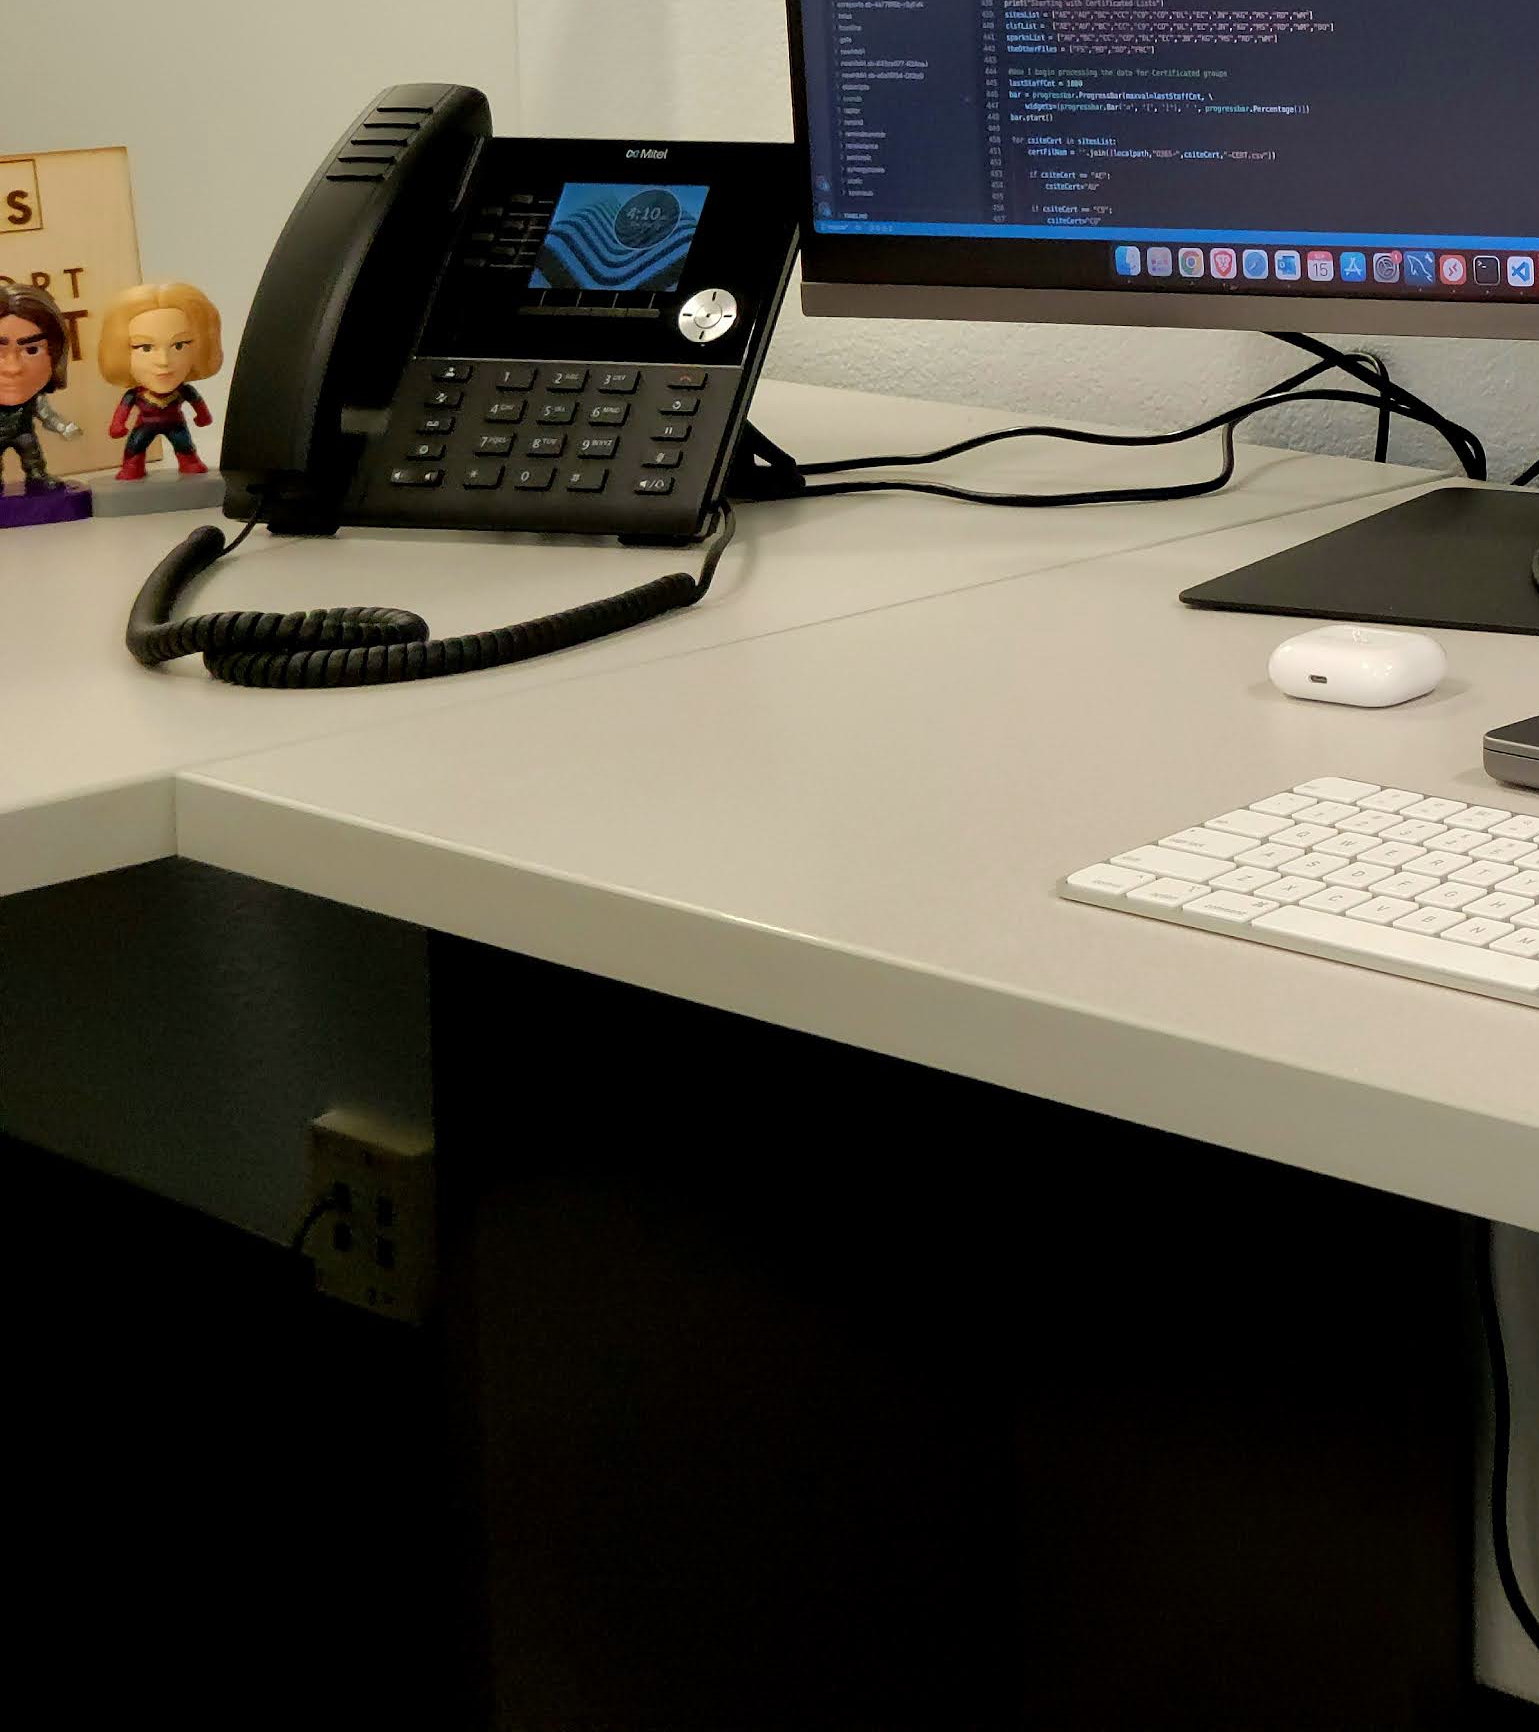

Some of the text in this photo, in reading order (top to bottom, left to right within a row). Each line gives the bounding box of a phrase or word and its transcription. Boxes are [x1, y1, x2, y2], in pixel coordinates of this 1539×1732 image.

[640, 148, 668, 159] Mitel
[1312, 263, 1328, 277] 15
[504, 372, 510, 382] 1
[554, 373, 562, 383] 2
[604, 375, 612, 385] 3
[490, 405, 499, 413] 4
[544, 406, 551, 416] 5
[592, 407, 600, 417] 6
[481, 437, 488, 446] 7
[532, 438, 540, 448] 8
[582, 440, 590, 450] 9
[521, 472, 529, 481] 0
